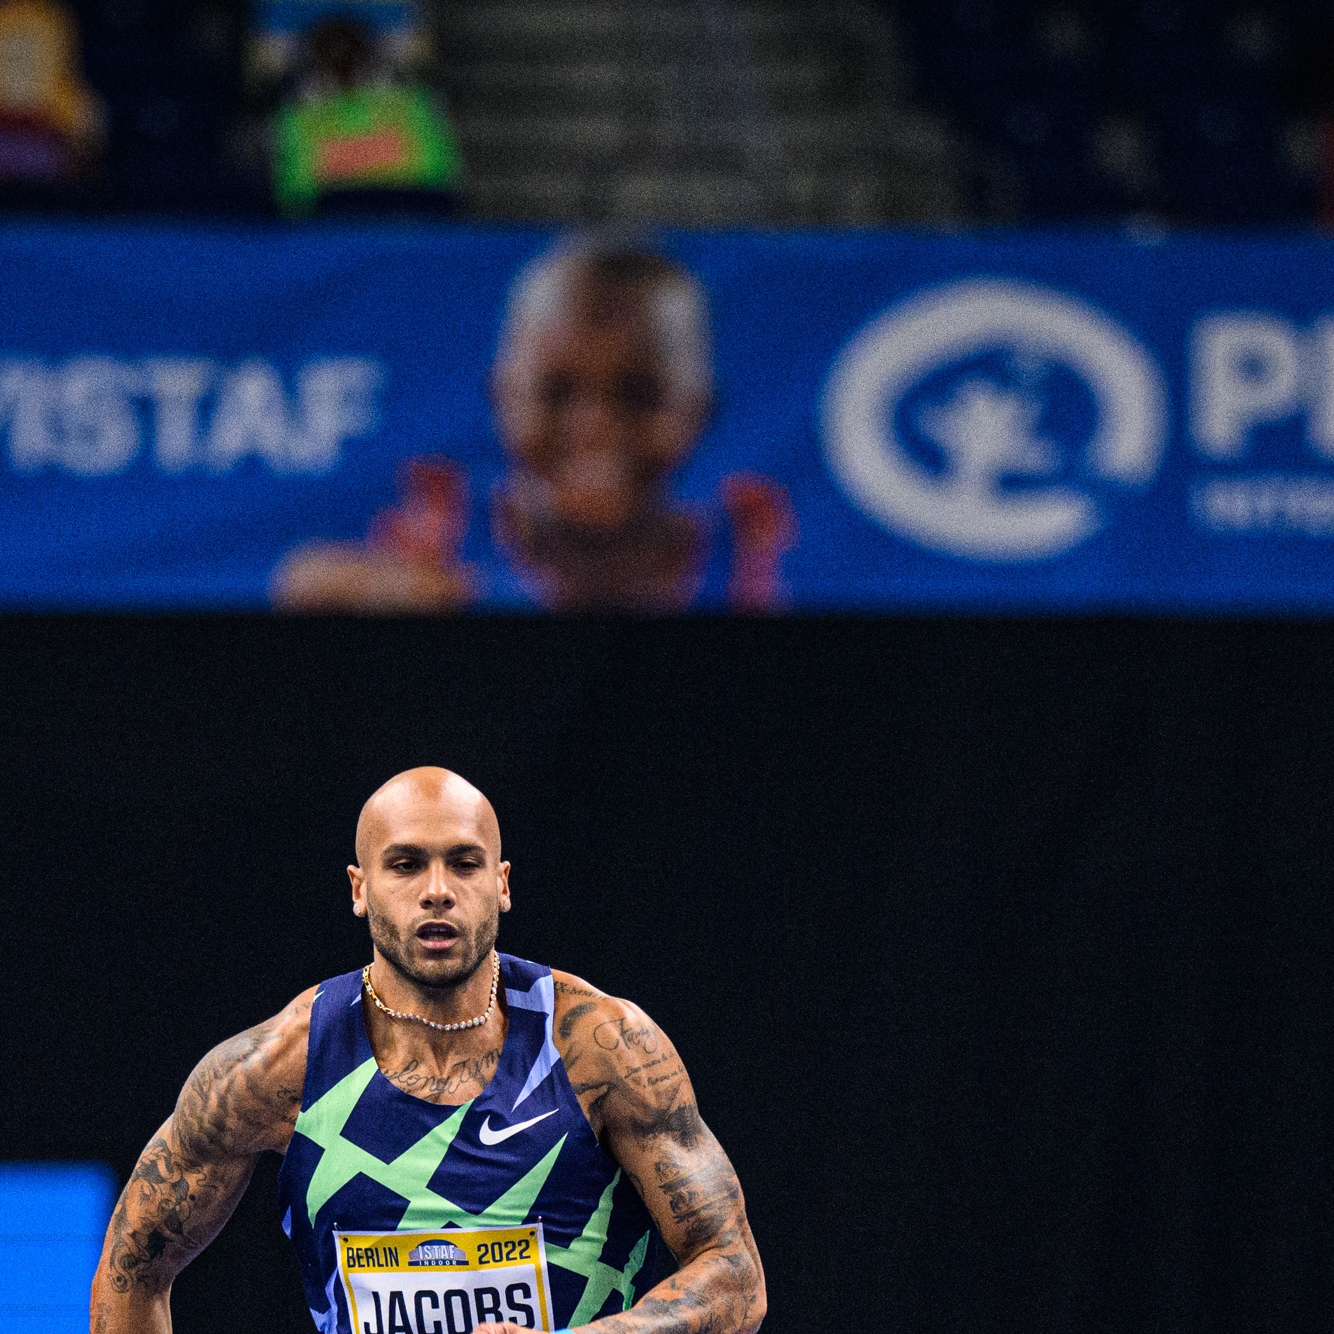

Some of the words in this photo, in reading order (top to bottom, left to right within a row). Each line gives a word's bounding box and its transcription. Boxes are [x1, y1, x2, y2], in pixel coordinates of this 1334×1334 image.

[346, 1246, 400, 1269] BERLIN
[417, 1244, 456, 1260] ISTAF
[476, 1239, 531, 1265] 2022
[418, 1259, 458, 1267] INDOOR
